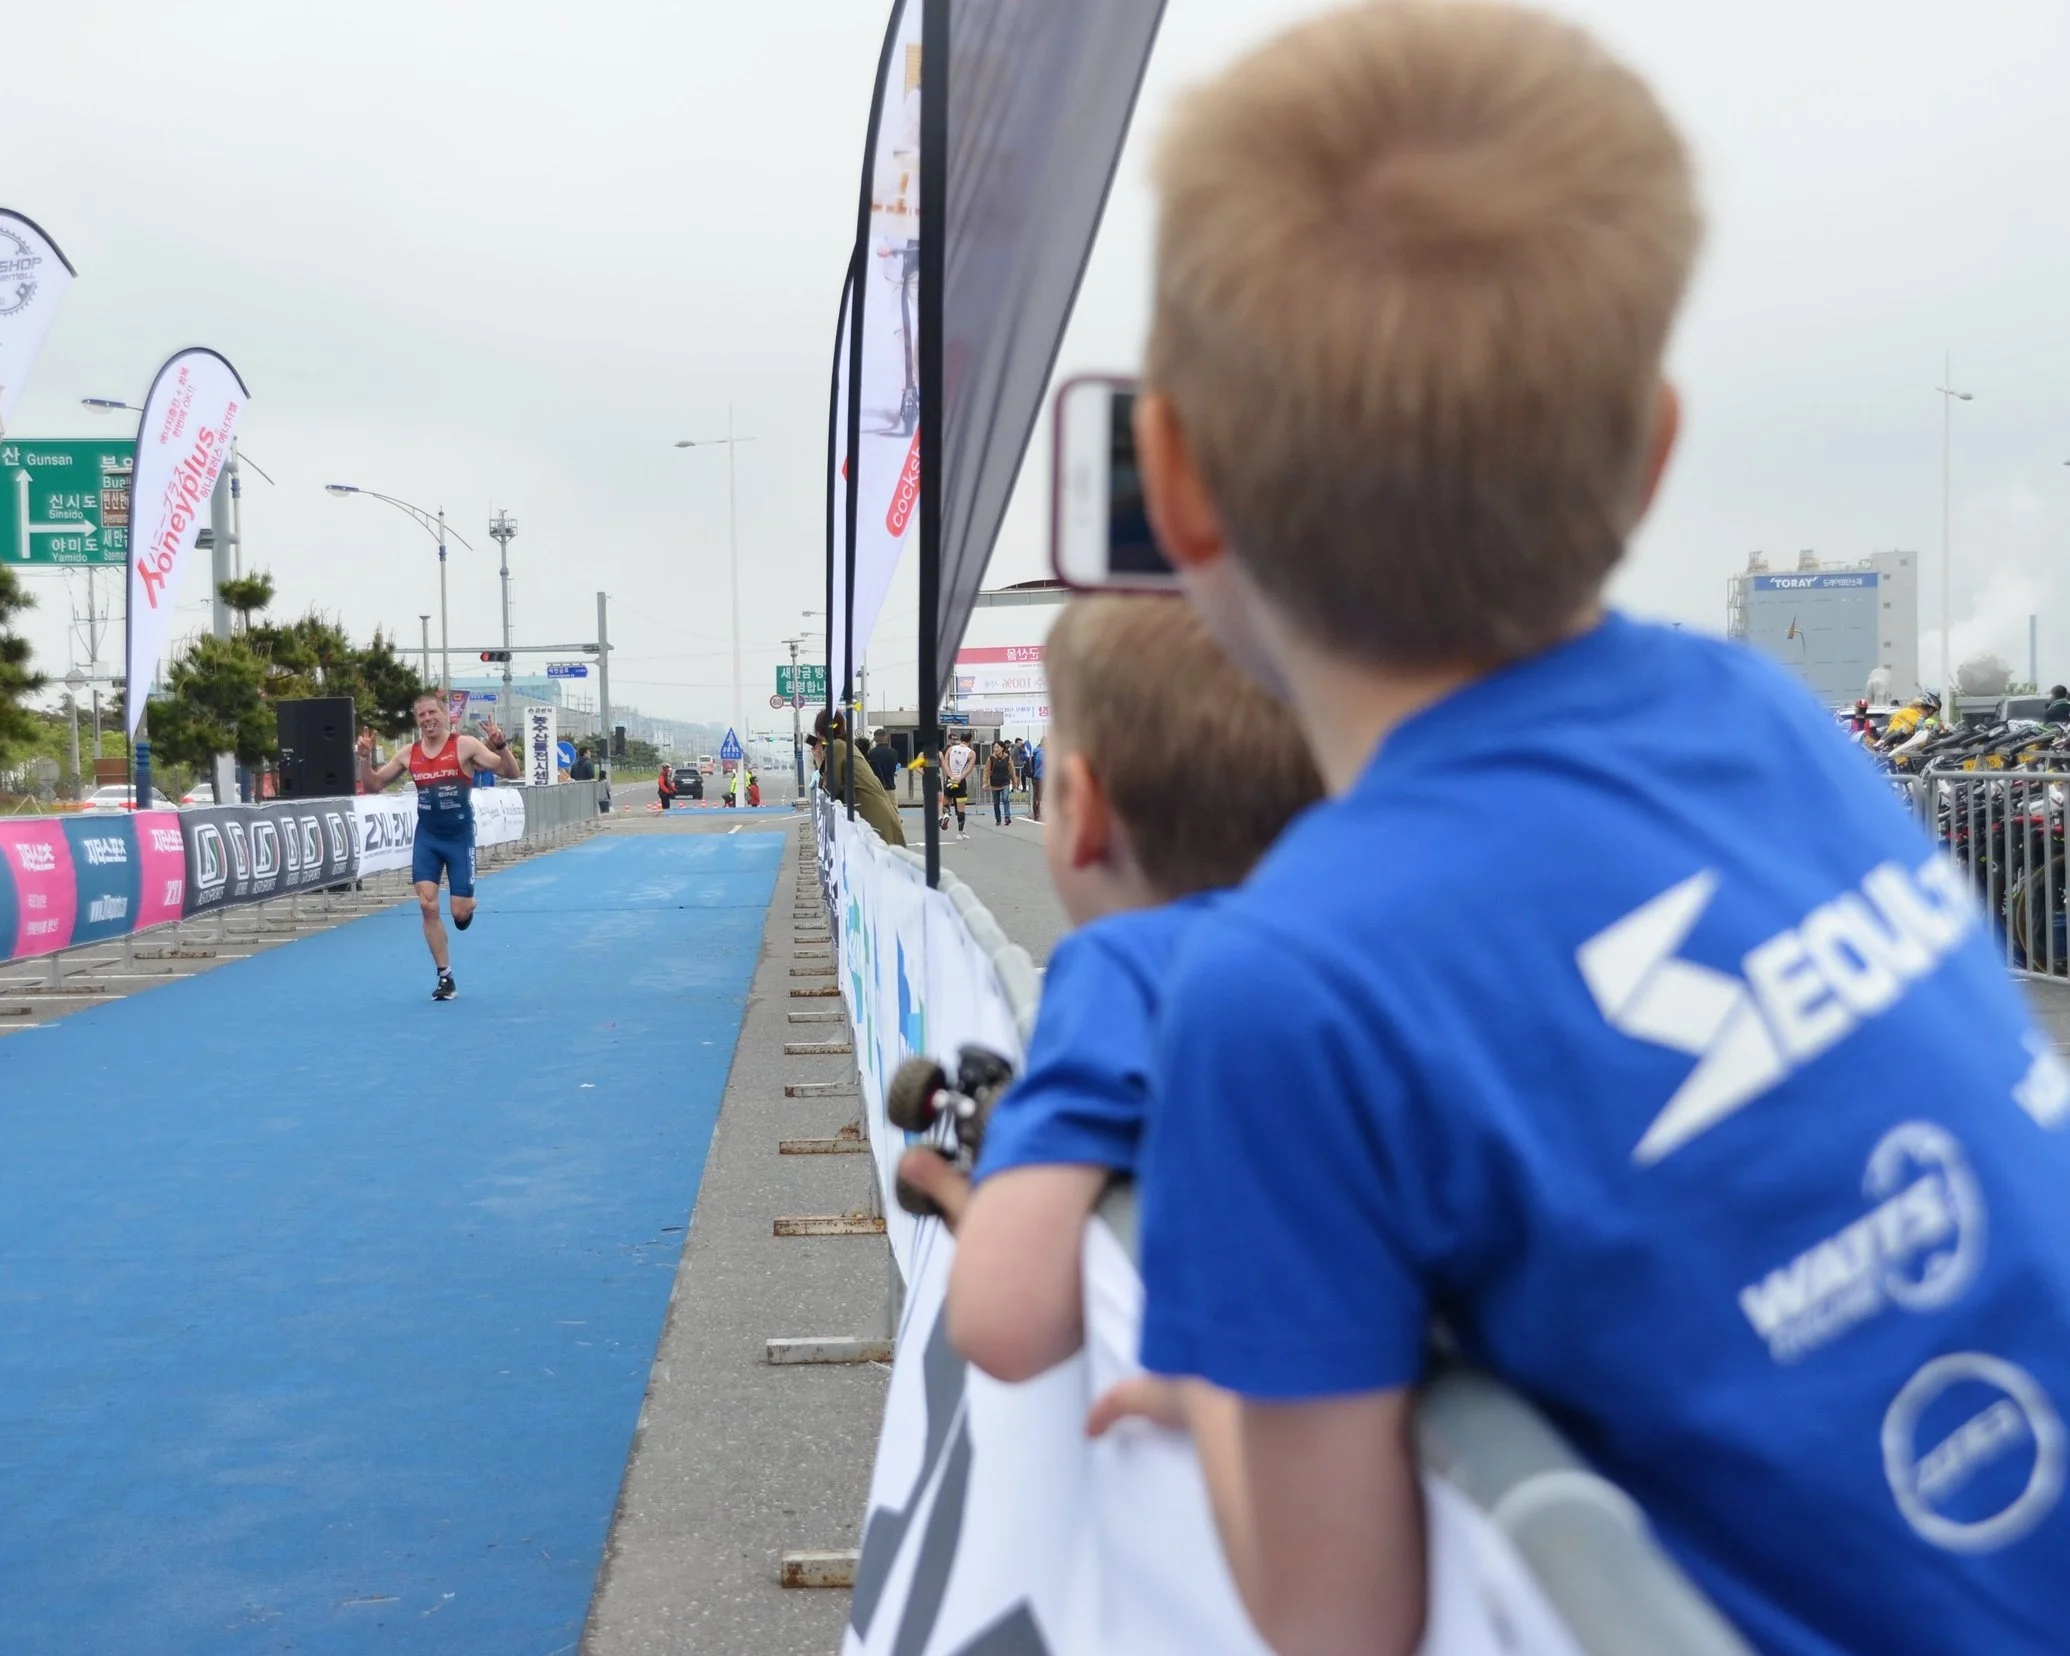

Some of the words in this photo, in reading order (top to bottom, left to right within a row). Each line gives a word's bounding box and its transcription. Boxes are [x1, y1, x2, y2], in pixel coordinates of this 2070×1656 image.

[26, 453, 73, 466] Gunsan
[49, 494, 98, 509] 신시도
[49, 509, 84, 520] Sinsido
[51, 537, 98, 552] 야미도
[52, 553, 88, 563] Yamido
[1771, 577, 1817, 588] TORAY
[364, 812, 393, 852] 2XU
